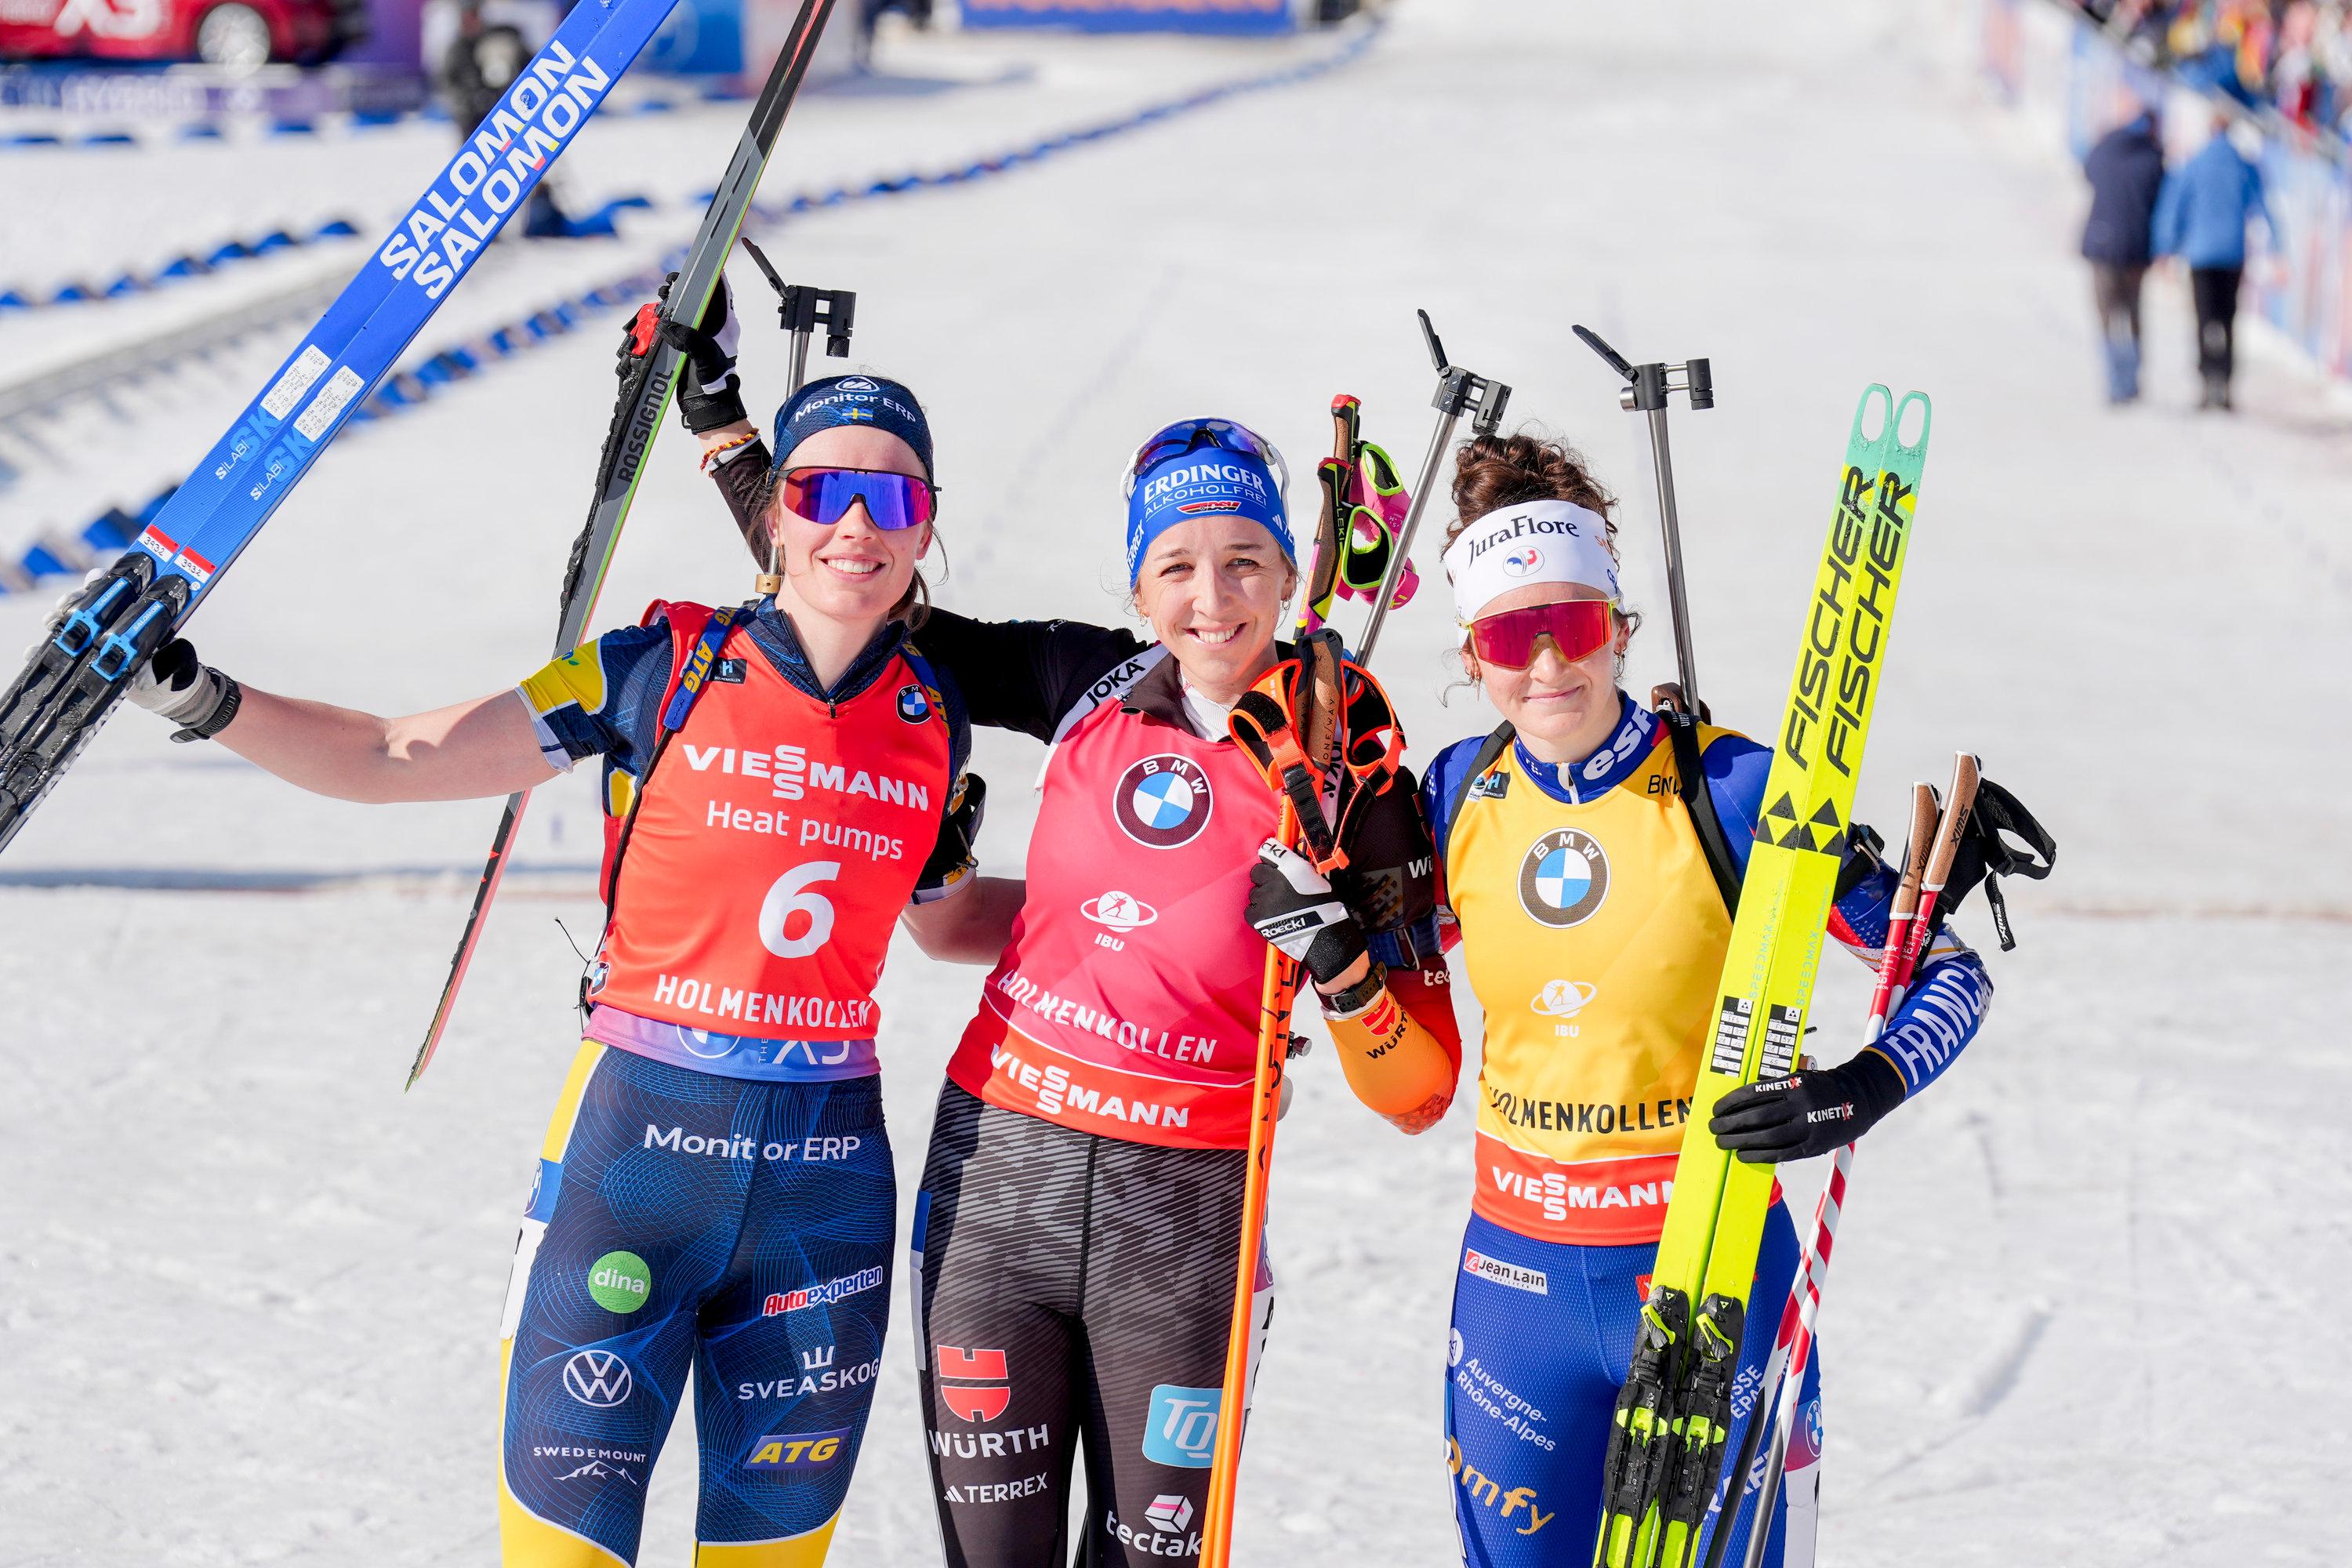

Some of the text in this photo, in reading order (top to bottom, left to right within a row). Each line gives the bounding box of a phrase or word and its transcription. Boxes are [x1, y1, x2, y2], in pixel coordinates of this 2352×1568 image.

[379, 39, 577, 281] SALOMON
[412, 56, 611, 299] SALOMON
[617, 368, 675, 483] ROSSIGNOL
[795, 393, 916, 423] Monitor ERP
[1144, 464, 1267, 504] ERDINGER
[1145, 485, 1267, 518] ALKOHOLFREI
[1336, 508, 1345, 541] LEKI
[1468, 515, 1580, 569] JuraFlore
[1785, 466, 1875, 771] FISCHER
[1826, 471, 1912, 778] FISCHER
[683, 641, 714, 693] ATG
[1086, 662, 1145, 707] JOKA
[900, 686, 919, 696] BM
[683, 745, 929, 811] VIESSMANN
[1142, 759, 1208, 795] BMW
[706, 800, 902, 861] Heat pumps
[1534, 833, 1600, 861] BMW
[758, 860, 840, 958] 6
[1094, 933, 1125, 952] IBU
[653, 973, 874, 1029] HOLMENKOLLEN
[996, 968, 1218, 1064] HOLMENKOLLEN
[1366, 1008, 1410, 1060] WÜRT
[1555, 1025, 1580, 1037] IBU
[990, 1043, 1190, 1127] VIESSMANN
[802, 1135, 862, 1162] ERP
[593, 1267, 645, 1295] dina
[1479, 1259, 1510, 1278] Jean
[764, 1266, 883, 1317] Autoexperten
[737, 1356, 880, 1400] SVEASKOG
[1465, 1358, 1548, 1423] Auvergne-
[1456, 1370, 1556, 1451] Rhône-Alpes
[533, 1446, 647, 1464] SWEDEMOUNT
[750, 1437, 840, 1464] ATG
[928, 1423, 1049, 1458] WÜRTH
[964, 1472, 1048, 1504] TERREX
